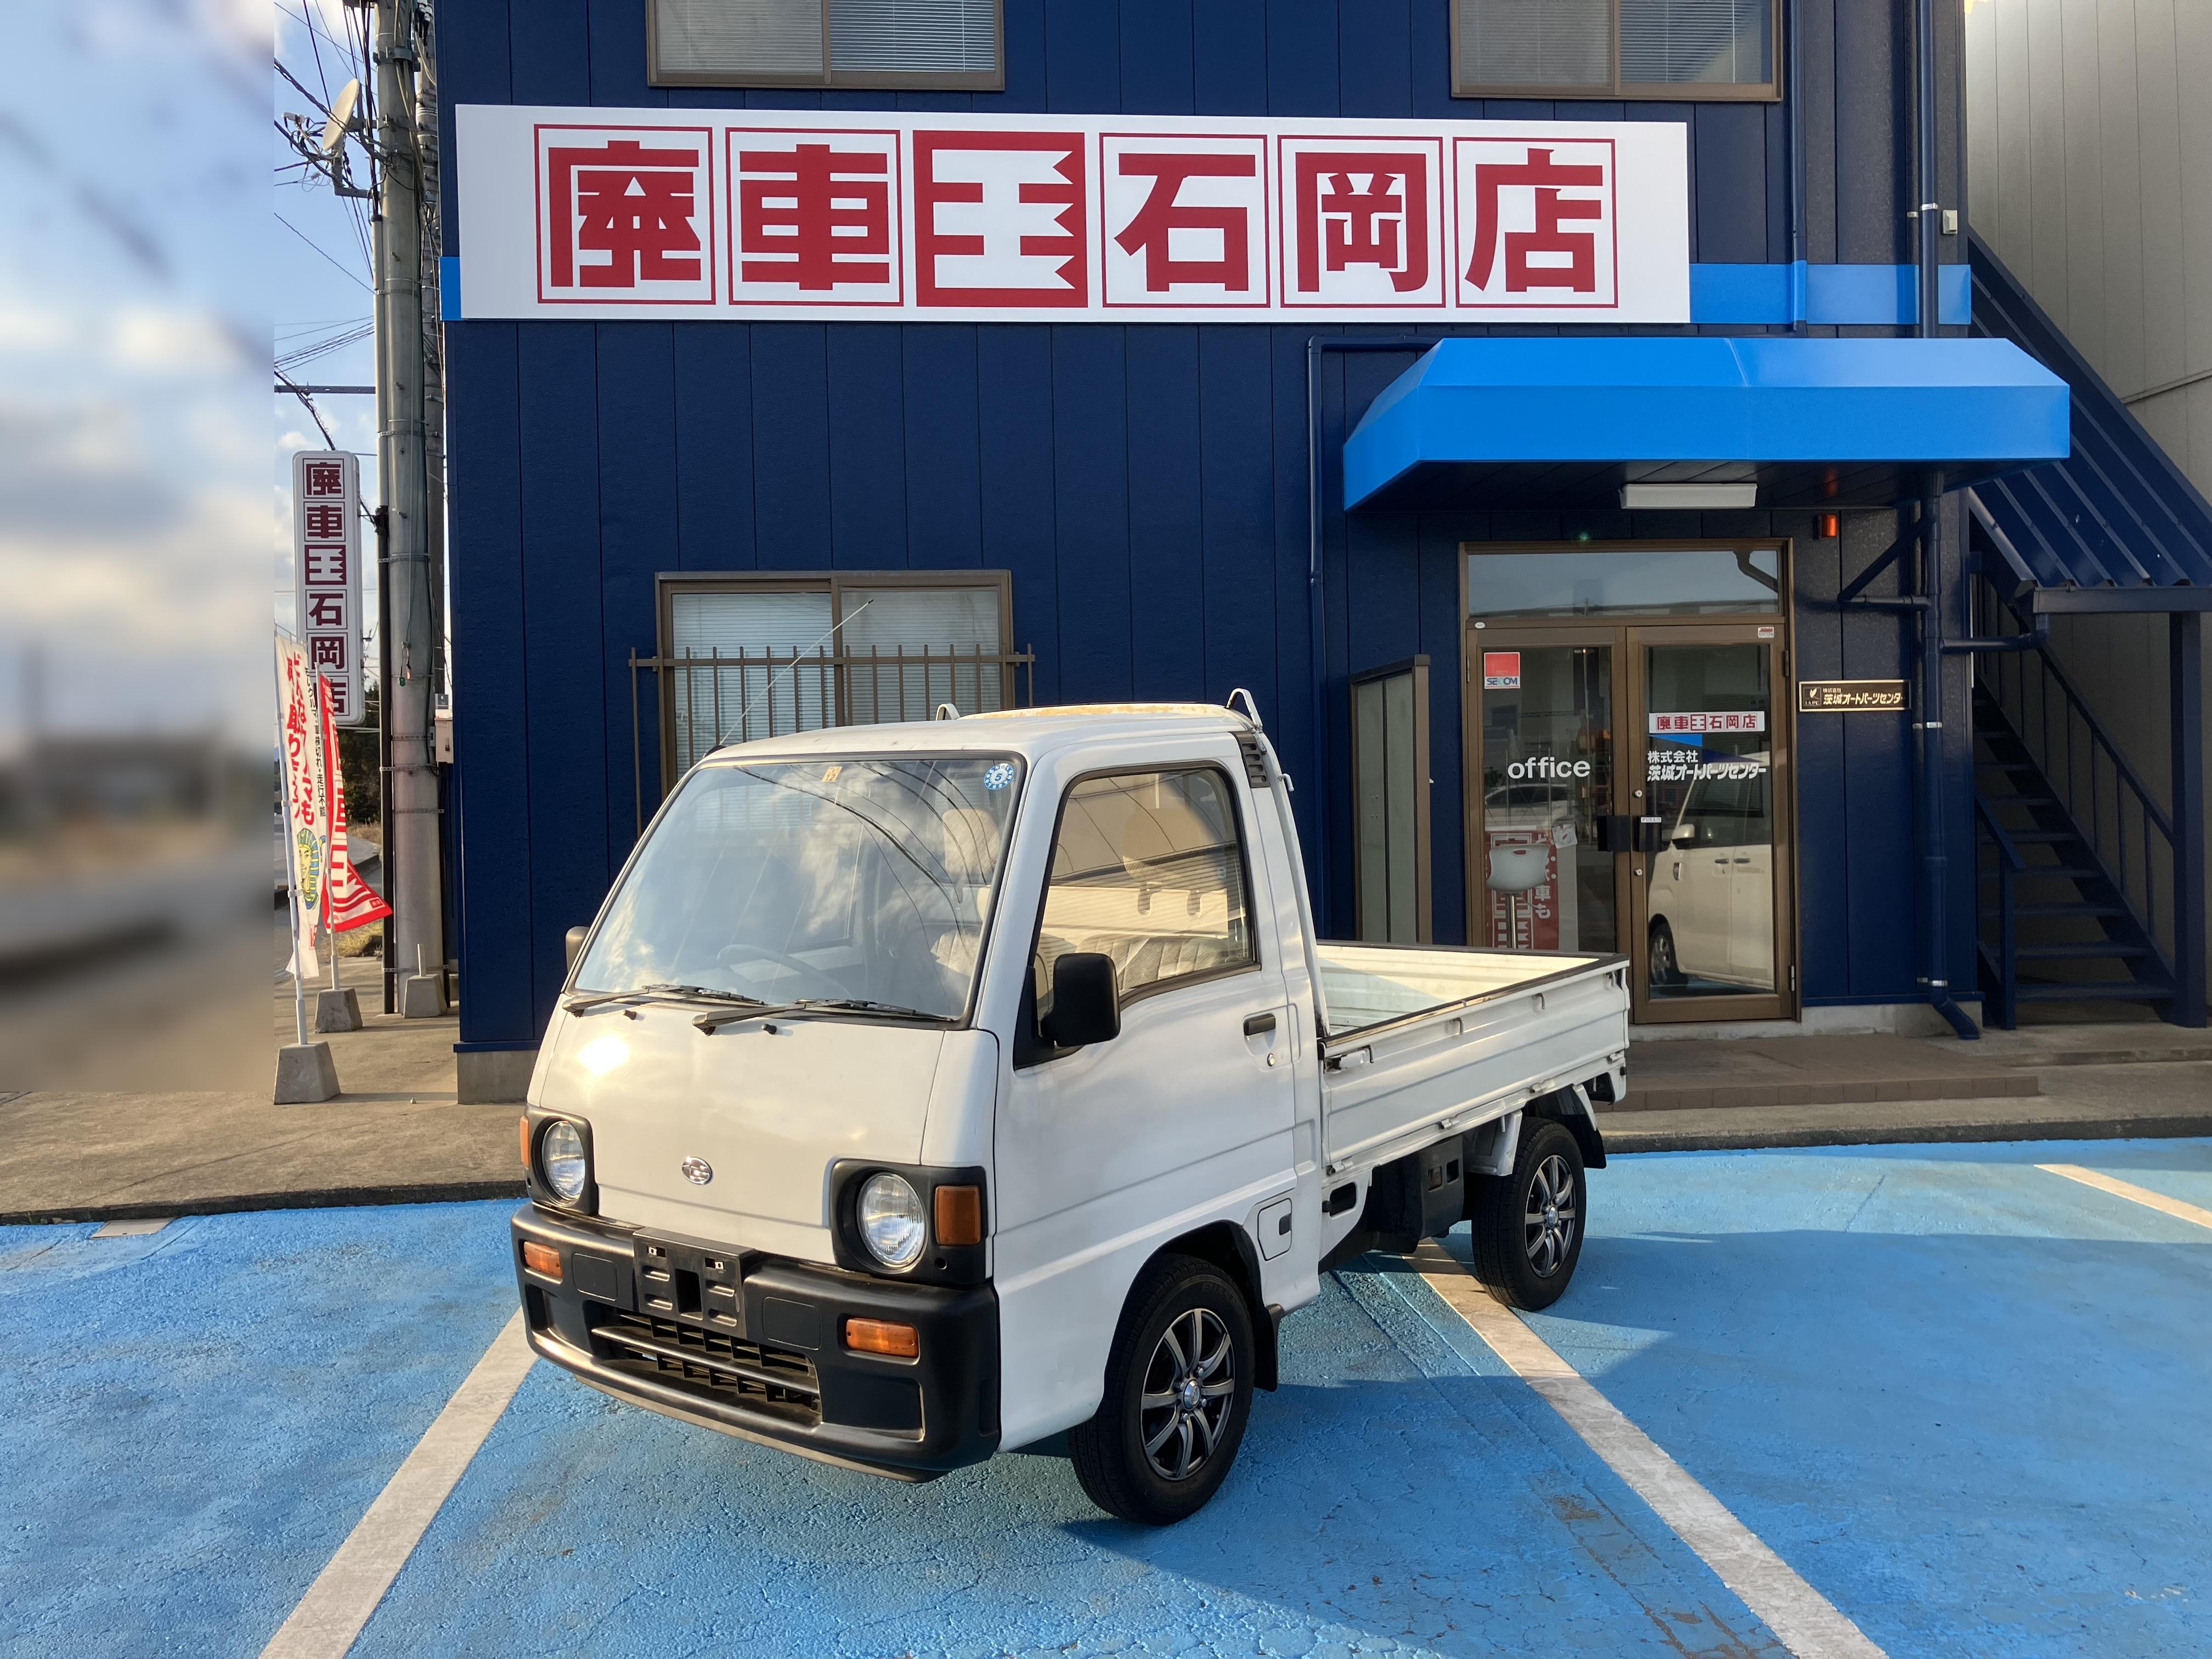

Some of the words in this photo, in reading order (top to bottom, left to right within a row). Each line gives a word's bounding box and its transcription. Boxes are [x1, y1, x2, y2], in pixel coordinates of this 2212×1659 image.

[548, 129, 1603, 308] 廃車王石岡店
[1657, 714, 1756, 731] 廃車王石岡店
[1647, 749, 1699, 764] 株式会社
[995, 773, 1003, 781] 5
[1508, 757, 1590, 779] office
[1647, 763, 1767, 782] 茨城オートパーツセンター
